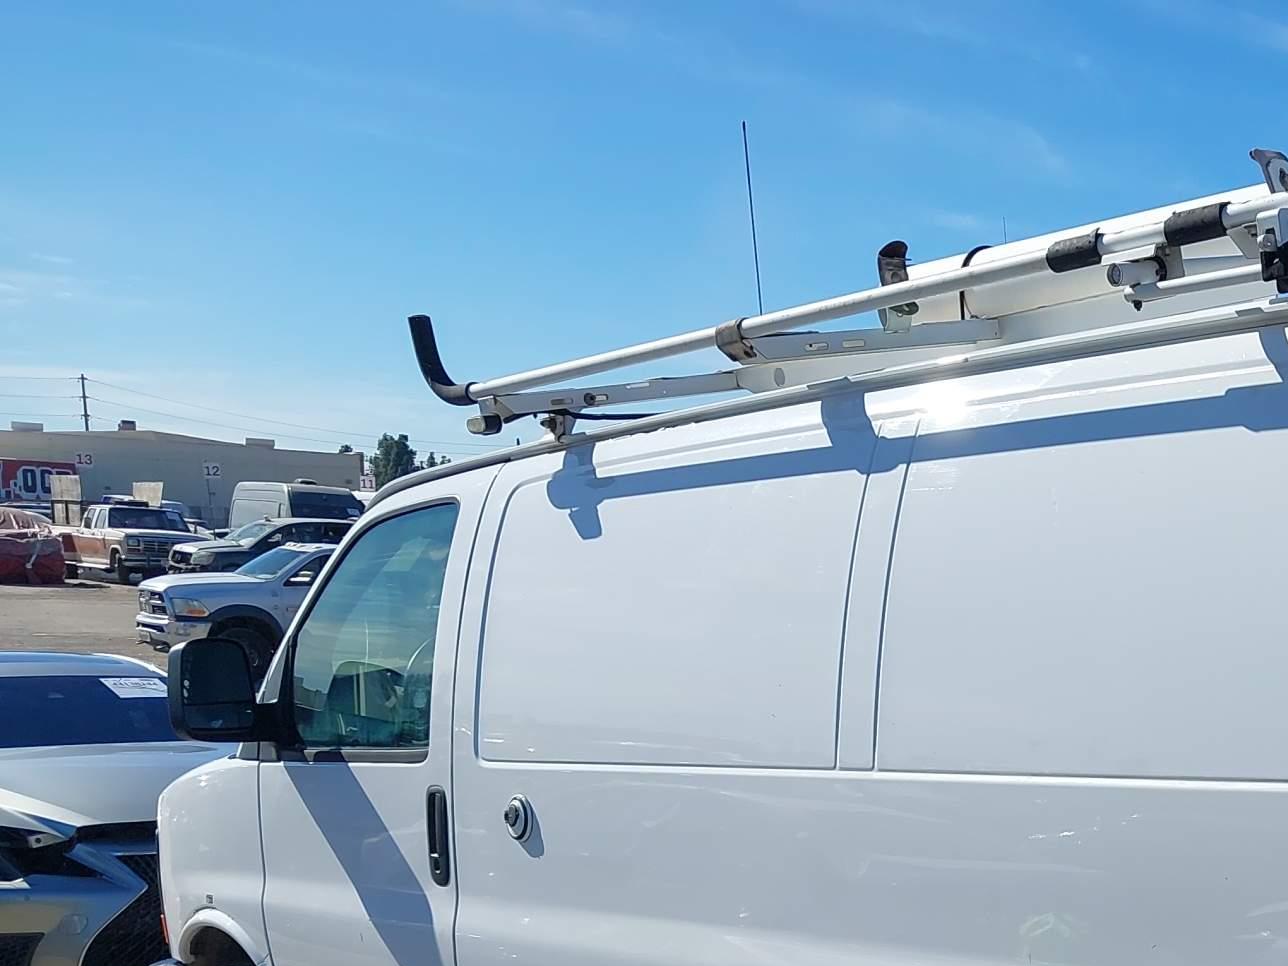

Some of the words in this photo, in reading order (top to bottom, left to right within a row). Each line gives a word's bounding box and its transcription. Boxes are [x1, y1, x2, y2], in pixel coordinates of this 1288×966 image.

[76, 453, 93, 465] 13
[203, 465, 221, 476] 12
[361, 478, 375, 490] 11
